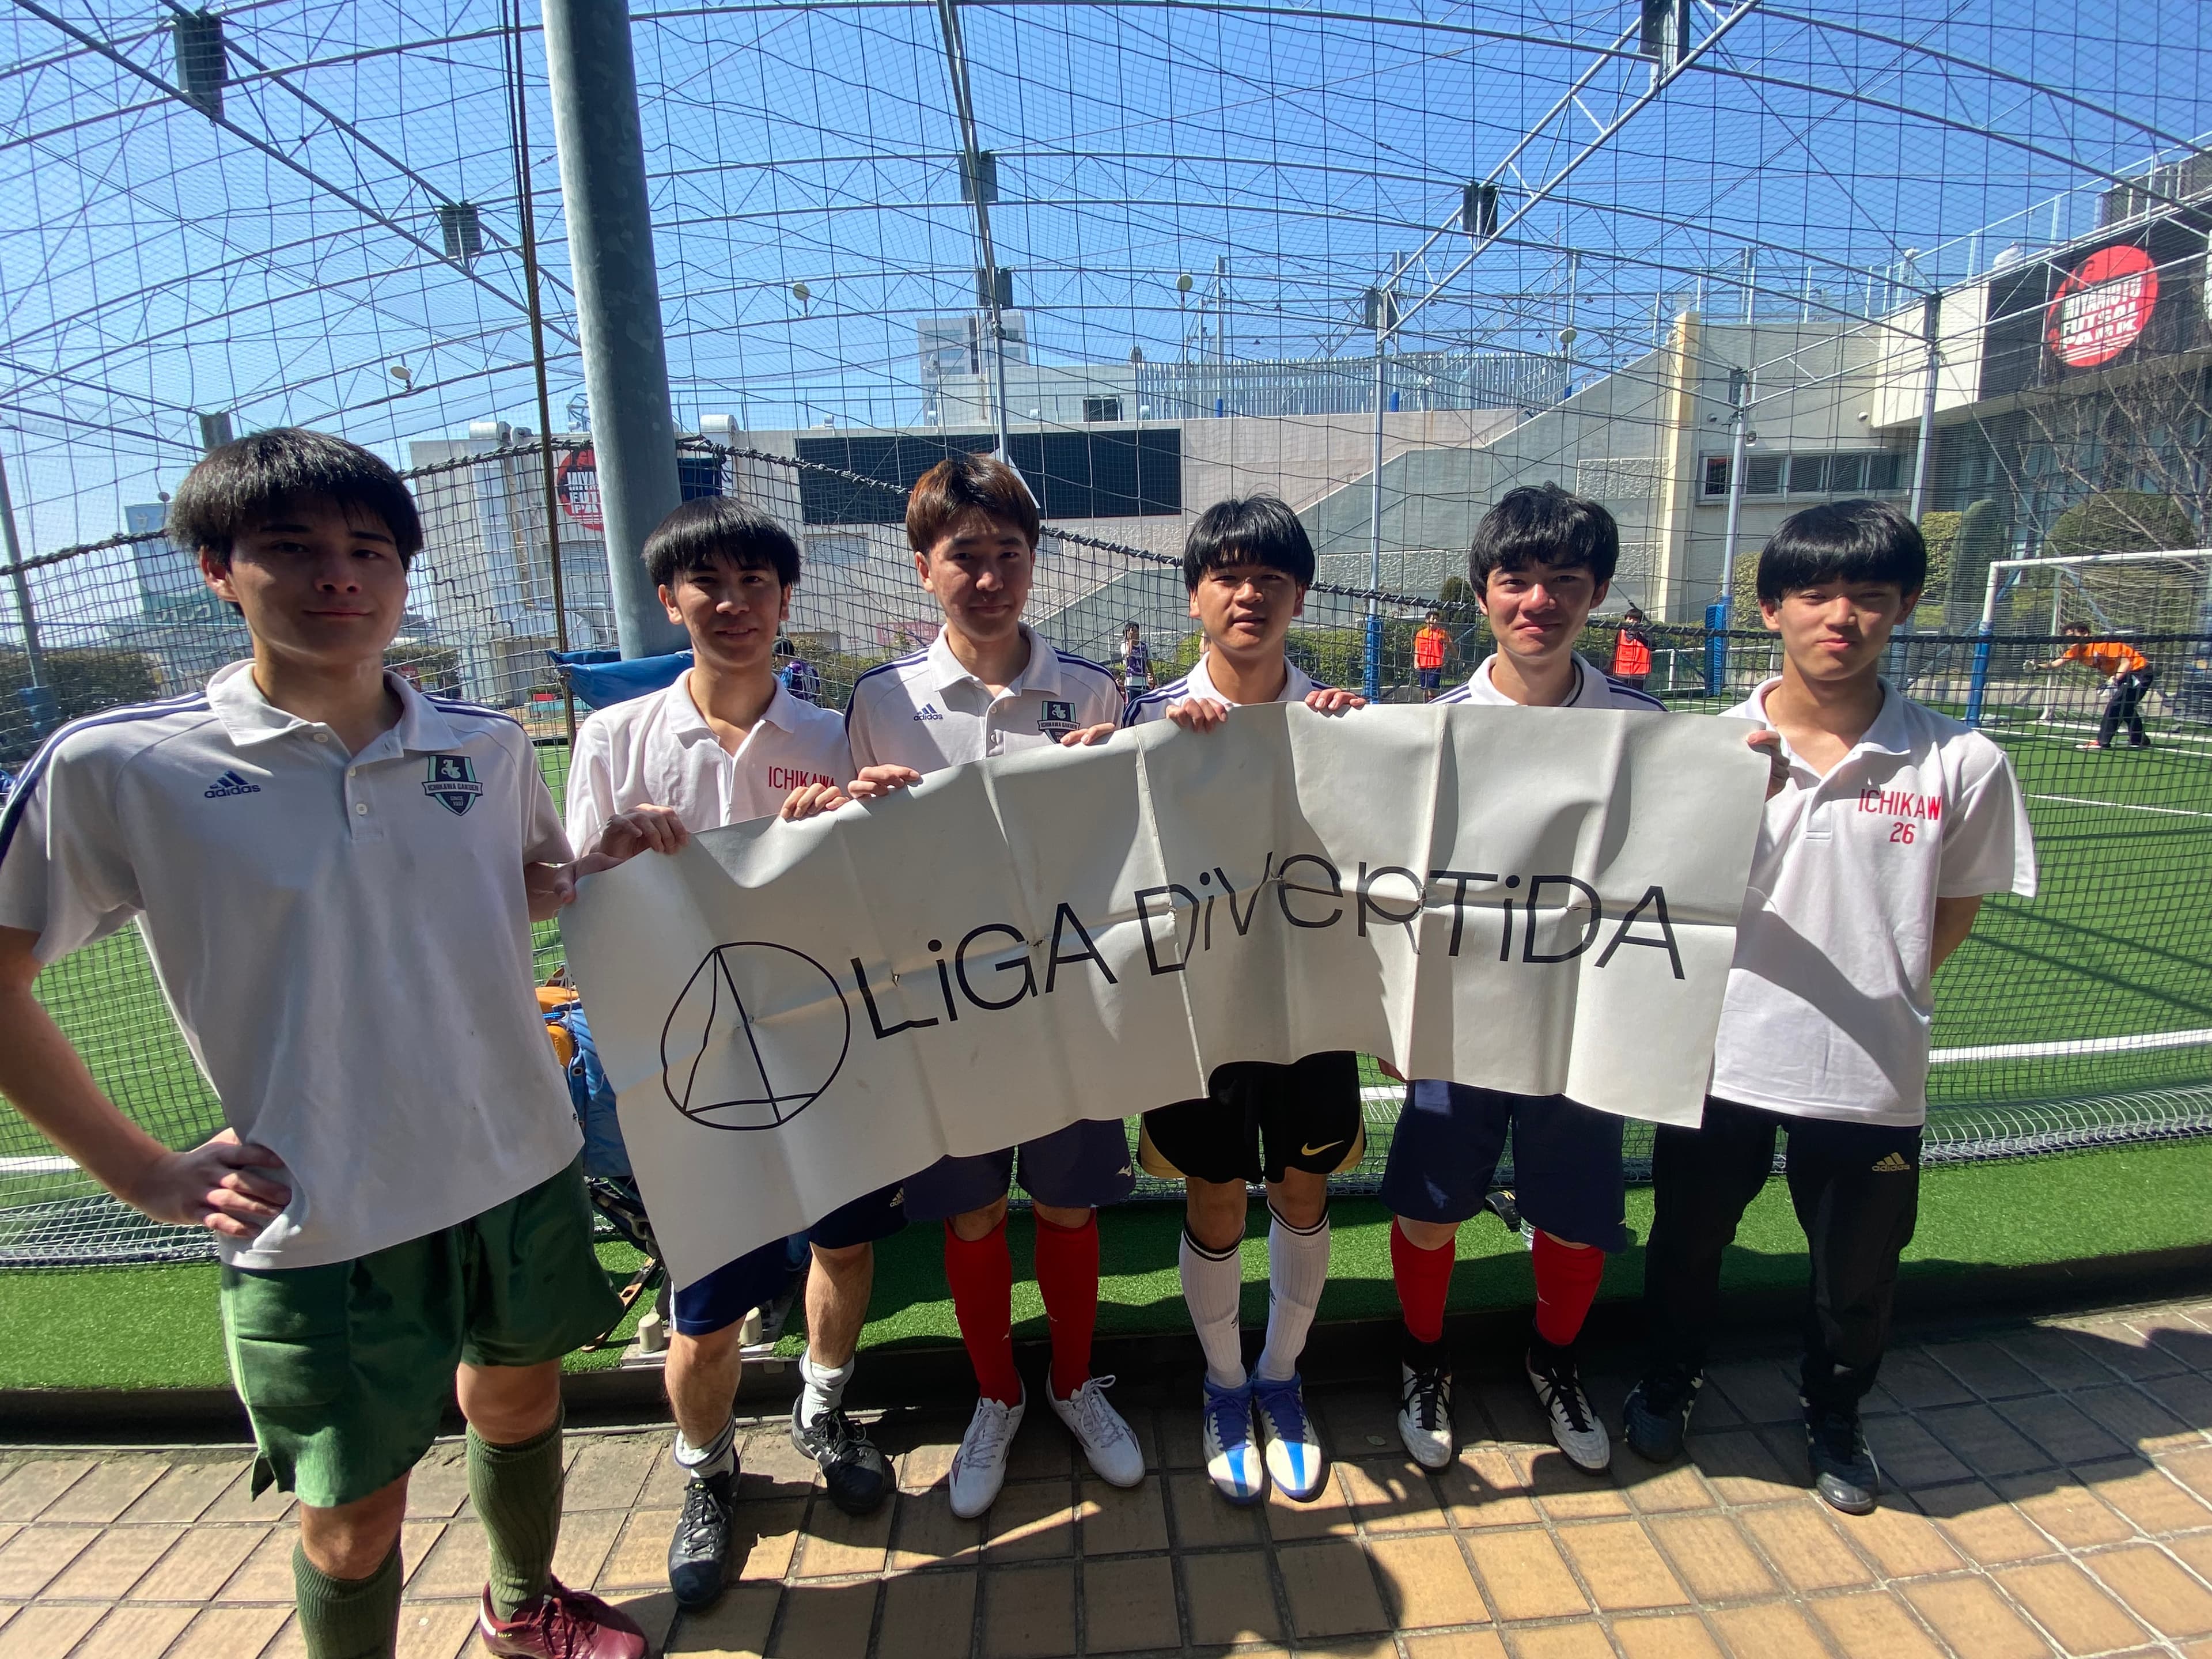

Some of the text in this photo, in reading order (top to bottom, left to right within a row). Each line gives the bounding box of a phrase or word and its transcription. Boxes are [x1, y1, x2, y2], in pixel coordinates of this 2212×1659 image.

[2063, 301, 2139, 338] FUTSAL
[2059, 317, 2137, 350] PARK
[567, 471, 599, 491] MIYA
[204, 784, 262, 798] adidas
[1889, 821, 1916, 844] 26
[1872, 1164, 1911, 1172] adidas
